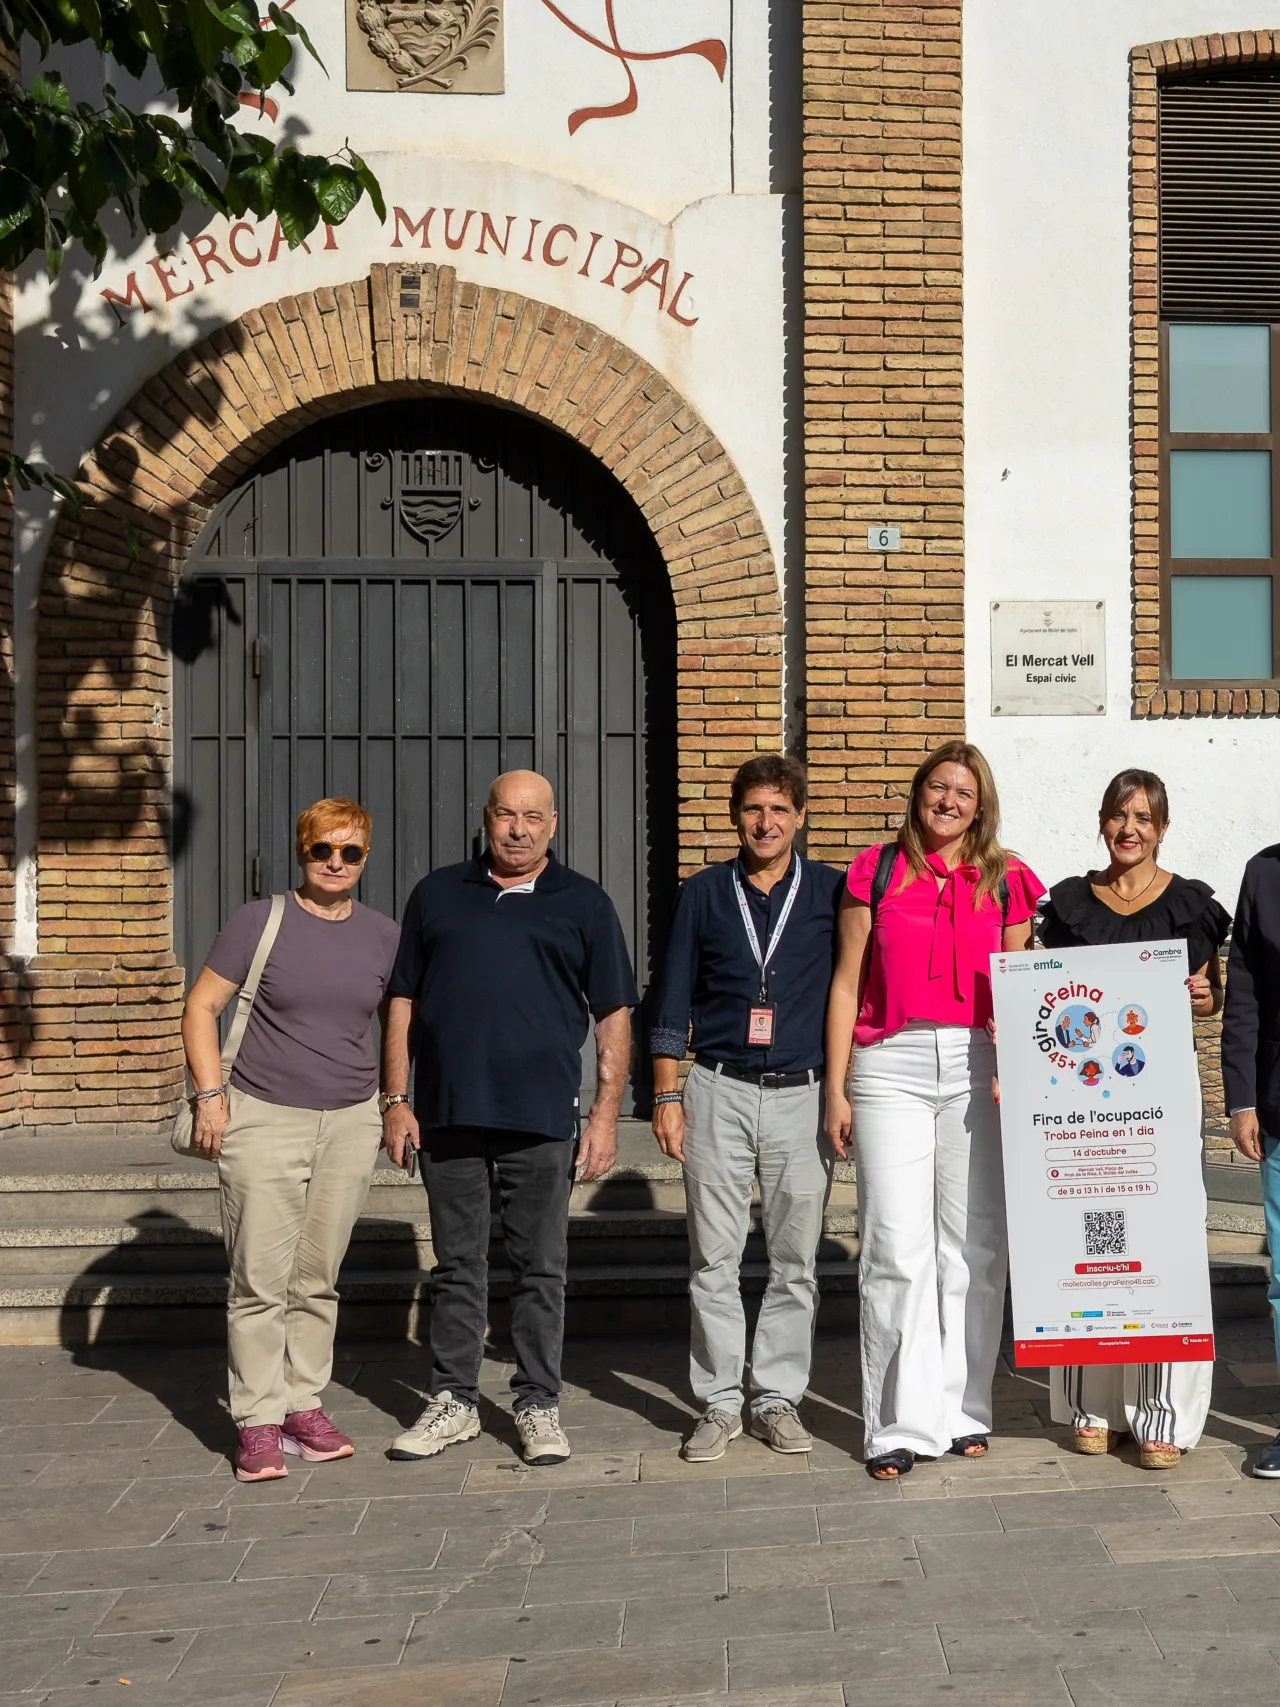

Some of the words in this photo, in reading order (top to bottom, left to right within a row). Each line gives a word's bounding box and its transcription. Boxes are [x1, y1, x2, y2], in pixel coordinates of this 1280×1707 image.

[390, 206, 700, 327] MUNICIPAL
[877, 529, 890, 547] 6
[1006, 654, 1017, 667] El
[1022, 654, 1069, 667] Mercat
[1071, 653, 1095, 667] Vell
[1026, 673, 1052, 685] Espai
[1055, 673, 1077, 683] cívic
[1153, 948, 1182, 957] Cambra
[1033, 1113, 1062, 1126] Fira
[1067, 1111, 1085, 1124] de
[1090, 1106, 1163, 1124] l'ocupació
[1044, 1130, 1077, 1141] Troba
[1080, 1128, 1109, 1139] feina
[1112, 1128, 1126, 1137] en
[1129, 1127, 1133, 1136] 1
[1137, 1126, 1155, 1135] dia
[1073, 1149, 1082, 1157] 14
[1084, 1147, 1127, 1157] d'octubre
[1069, 1187, 1074, 1195] 9
[1094, 1186, 1099, 1194] h
[1117, 1185, 1126, 1193] 15
[1135, 1184, 1143, 1192] 19
[1086, 1263, 1130, 1273] Inscriu-t'hi
